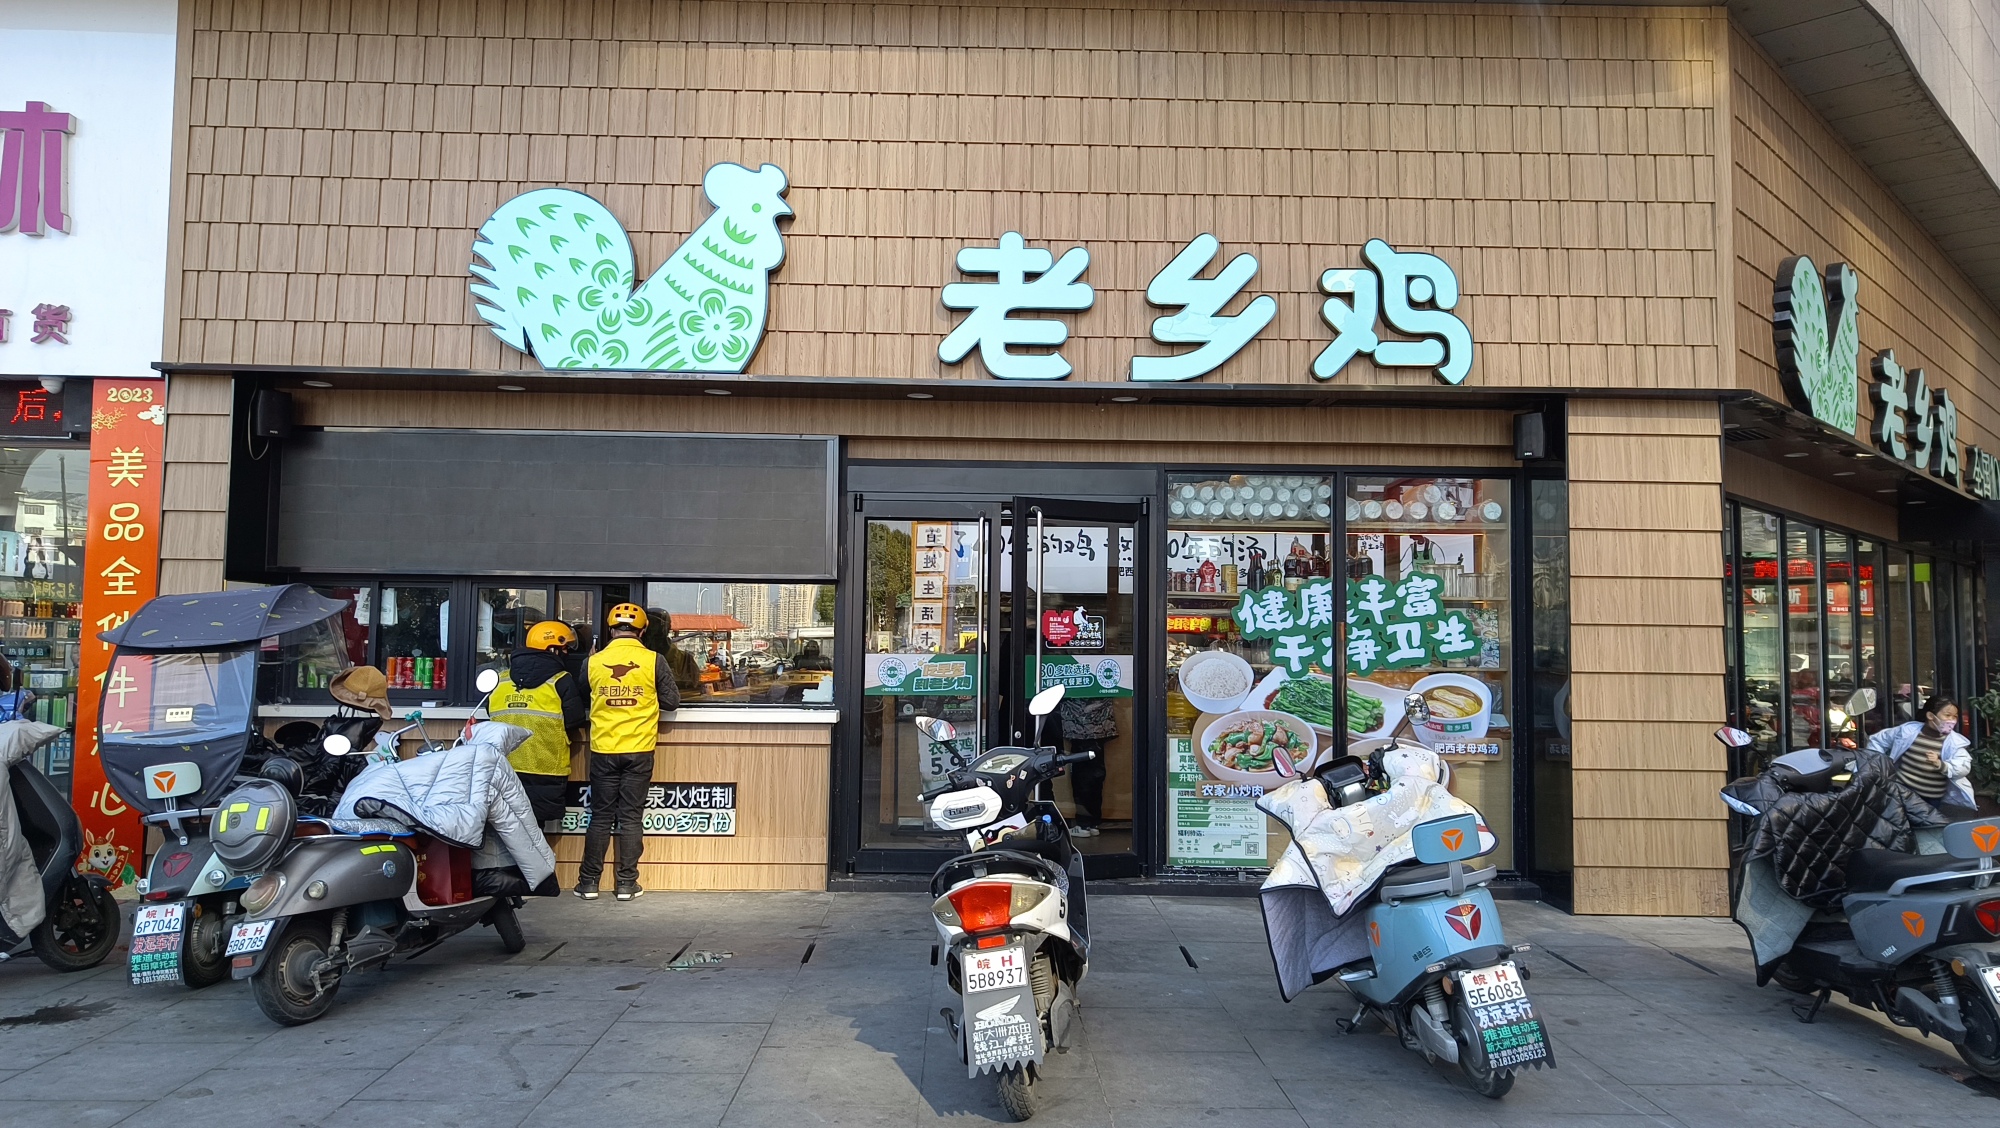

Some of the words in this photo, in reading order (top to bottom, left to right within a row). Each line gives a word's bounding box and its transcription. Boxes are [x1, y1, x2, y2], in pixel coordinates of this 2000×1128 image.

[937, 231, 1475, 385] 老乡鸡
[106, 387, 154, 403] 2023
[1874, 348, 1960, 488] 老乡鸡
[1237, 575, 1438, 634] 健康丰富
[1274, 616, 1476, 673] 干净卫生
[923, 662, 966, 677] 吃早餐
[598, 685, 644, 697] 美团外卖
[914, 676, 972, 691] 到老乡鸡
[504, 694, 534, 703] 美团外卖
[928, 737, 977, 756] 农家鸡
[1434, 742, 1499, 755] 肥西老母鸡汤
[1179, 774, 1204, 783] 升职快
[578, 785, 733, 809] 农泉水炖制
[1201, 784, 1264, 797] 农家小炒肉
[145, 909, 157, 919] 皖
[164, 908, 175, 918] H
[136, 917, 180, 934] 6P7042
[237, 928, 249, 937] 皖
[254, 926, 264, 936] H
[132, 932, 181, 954] 发远车行
[227, 935, 265, 953] 5B8785
[131, 951, 178, 964] 雅迪电动车
[131, 960, 178, 972] 本田摩托车
[977, 958, 991, 969] 皖
[1001, 955, 1013, 967] H
[969, 967, 1023, 990] 5B8937
[1473, 973, 1488, 986] 皖
[1495, 969, 1508, 982] H
[1468, 981, 1522, 1005] 5E6083
[974, 1014, 1025, 1030] HONDA
[1474, 998, 1534, 1029] 发远车行
[972, 1022, 1032, 1042] 新大洲本田
[1482, 1021, 1539, 1042] 雅迪电动车
[974, 1033, 1034, 1052] 钱江摩托
